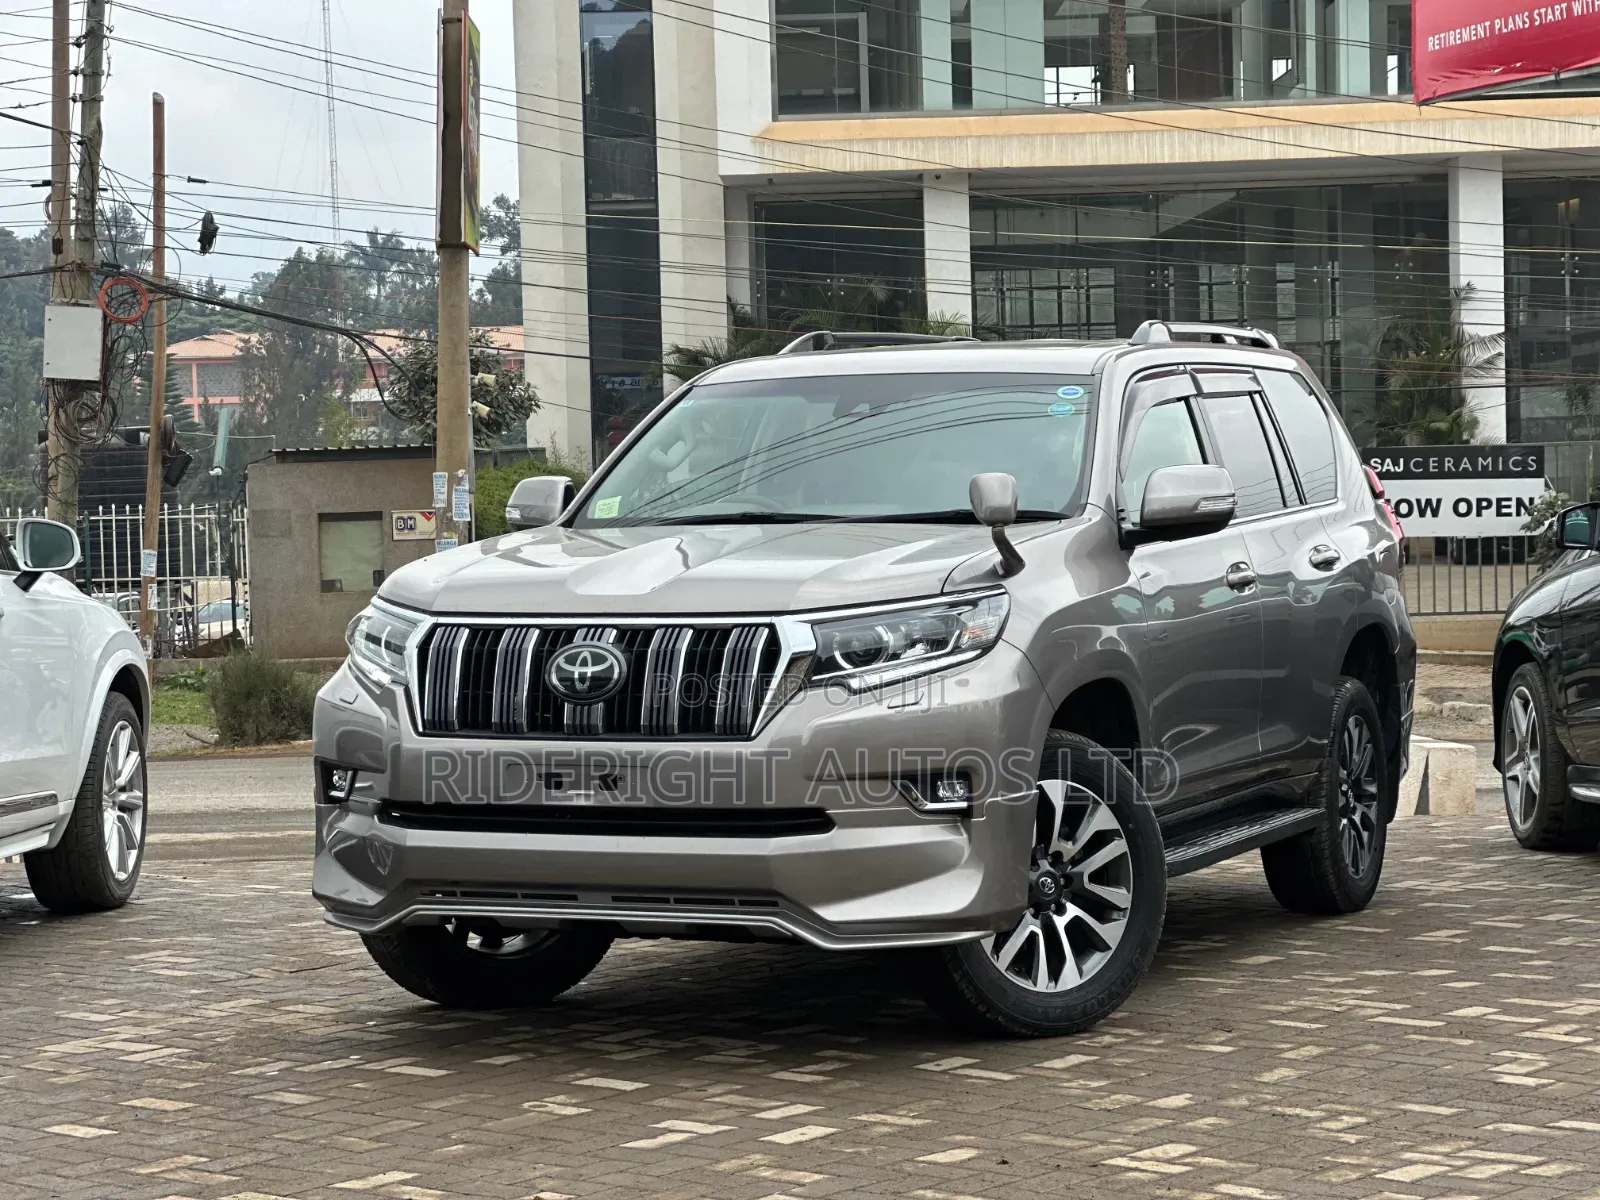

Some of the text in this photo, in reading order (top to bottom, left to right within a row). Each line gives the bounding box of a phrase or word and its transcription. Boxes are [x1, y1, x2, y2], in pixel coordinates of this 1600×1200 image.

[1428, 21, 1491, 51] RETIREMENT
[1494, 11, 1530, 35] PLANS
[1533, 3, 1568, 26] START
[1370, 455, 1537, 473] SAJ CERAMICS
[1386, 497, 1535, 518] OW OPEN
